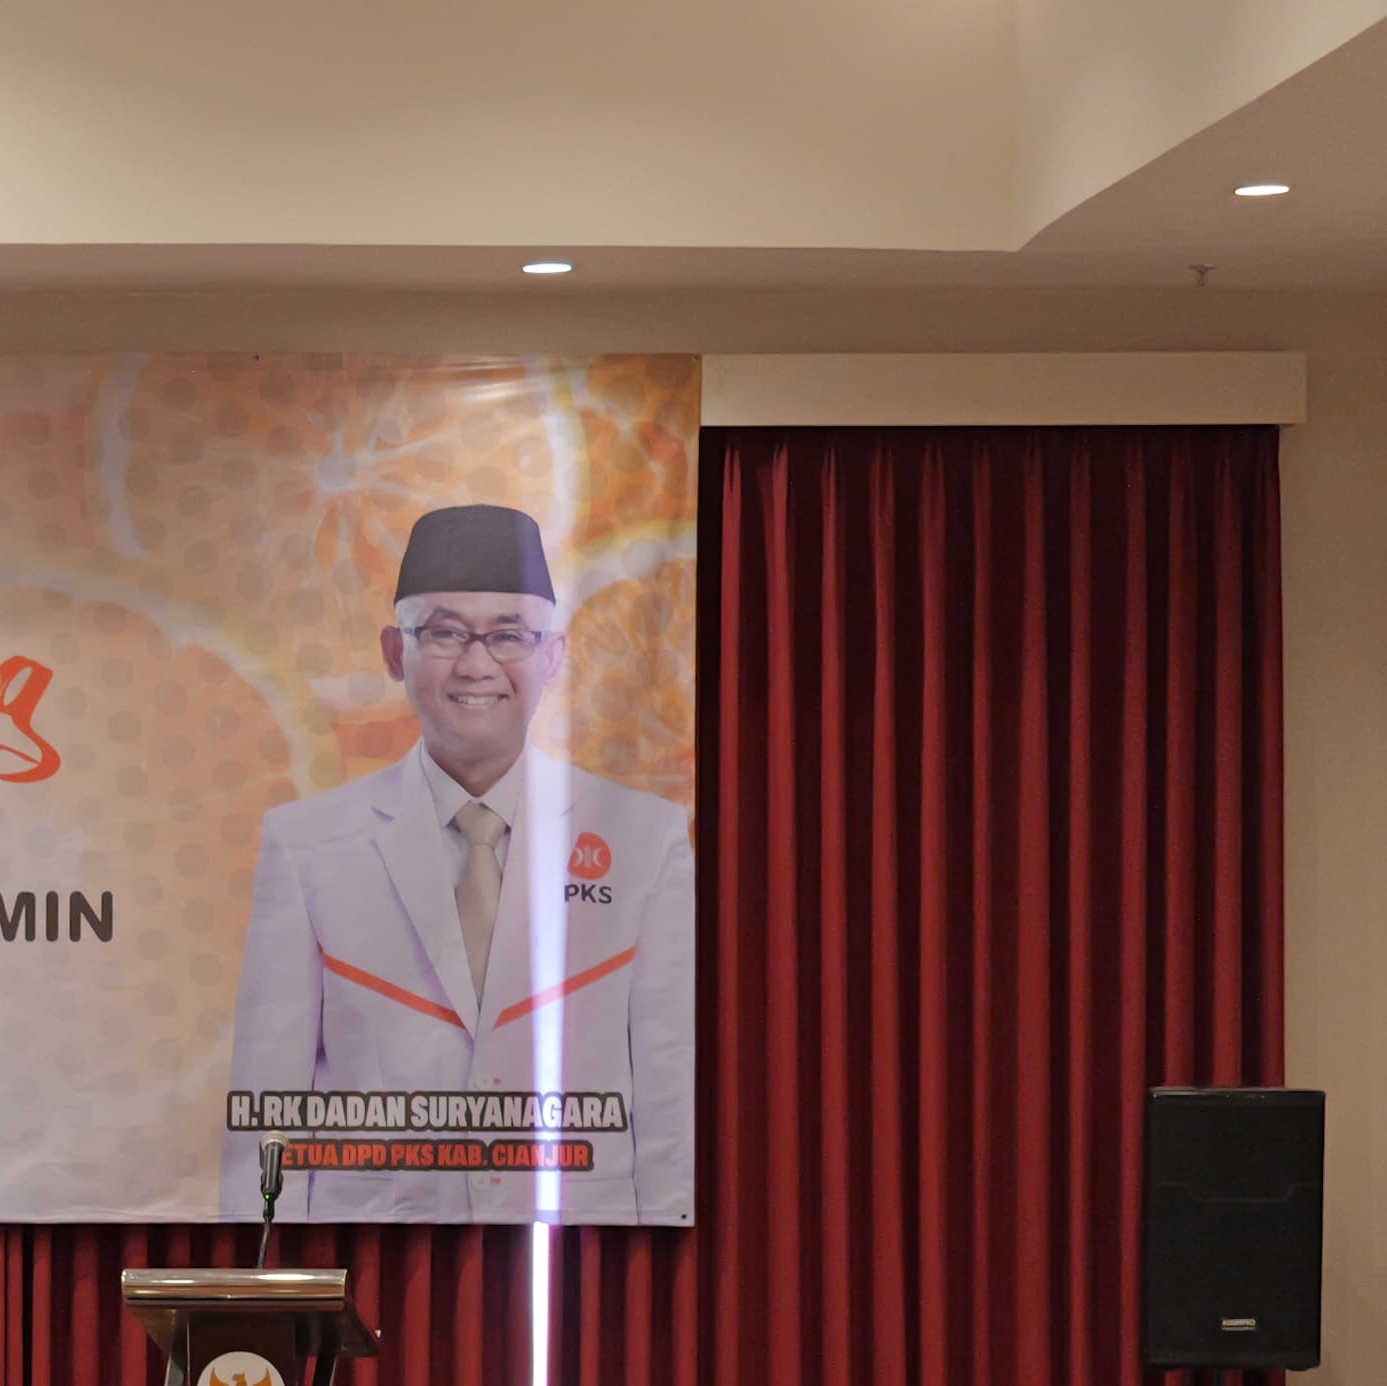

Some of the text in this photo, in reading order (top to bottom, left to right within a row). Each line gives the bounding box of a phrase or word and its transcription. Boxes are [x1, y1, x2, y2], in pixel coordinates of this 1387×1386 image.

[564, 884, 612, 904] PKS
[231, 1096, 624, 1127] H. RK DADAN SURYANAGARA
[282, 1144, 590, 1167] ETUA DPD PKS KAB. CIANJUR
